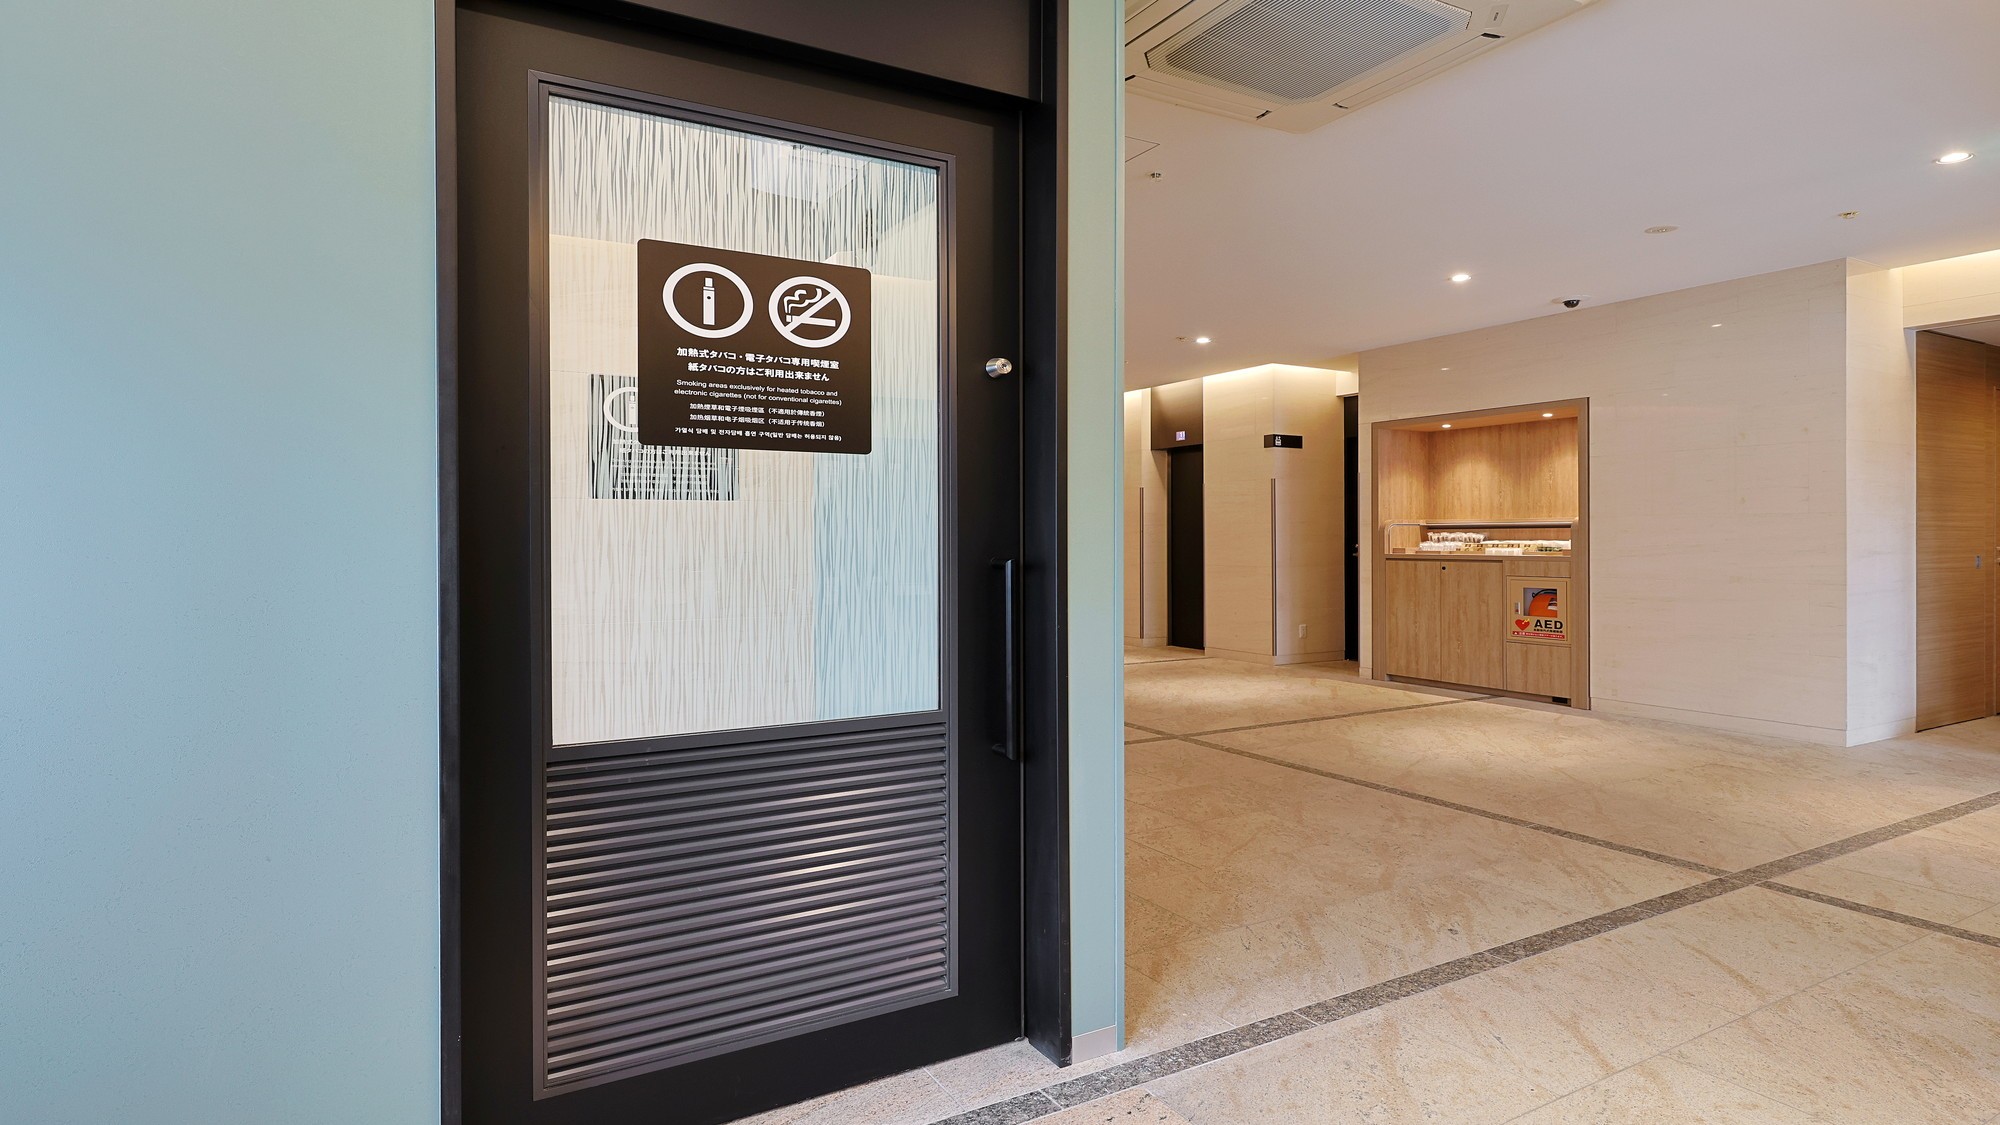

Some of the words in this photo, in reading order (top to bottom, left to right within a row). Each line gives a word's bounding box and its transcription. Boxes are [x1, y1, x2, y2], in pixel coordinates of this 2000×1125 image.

[676, 346, 840, 370] 加熱式タバコ・電子タバコ専用喫煙室
[688, 362, 830, 382] 紙タバコの方はご利用出来ません
[676, 380, 707, 388] Smoking
[729, 384, 765, 392] exclusively
[810, 398, 842, 406] cigarettes)
[1534, 619, 1563, 630] AED
